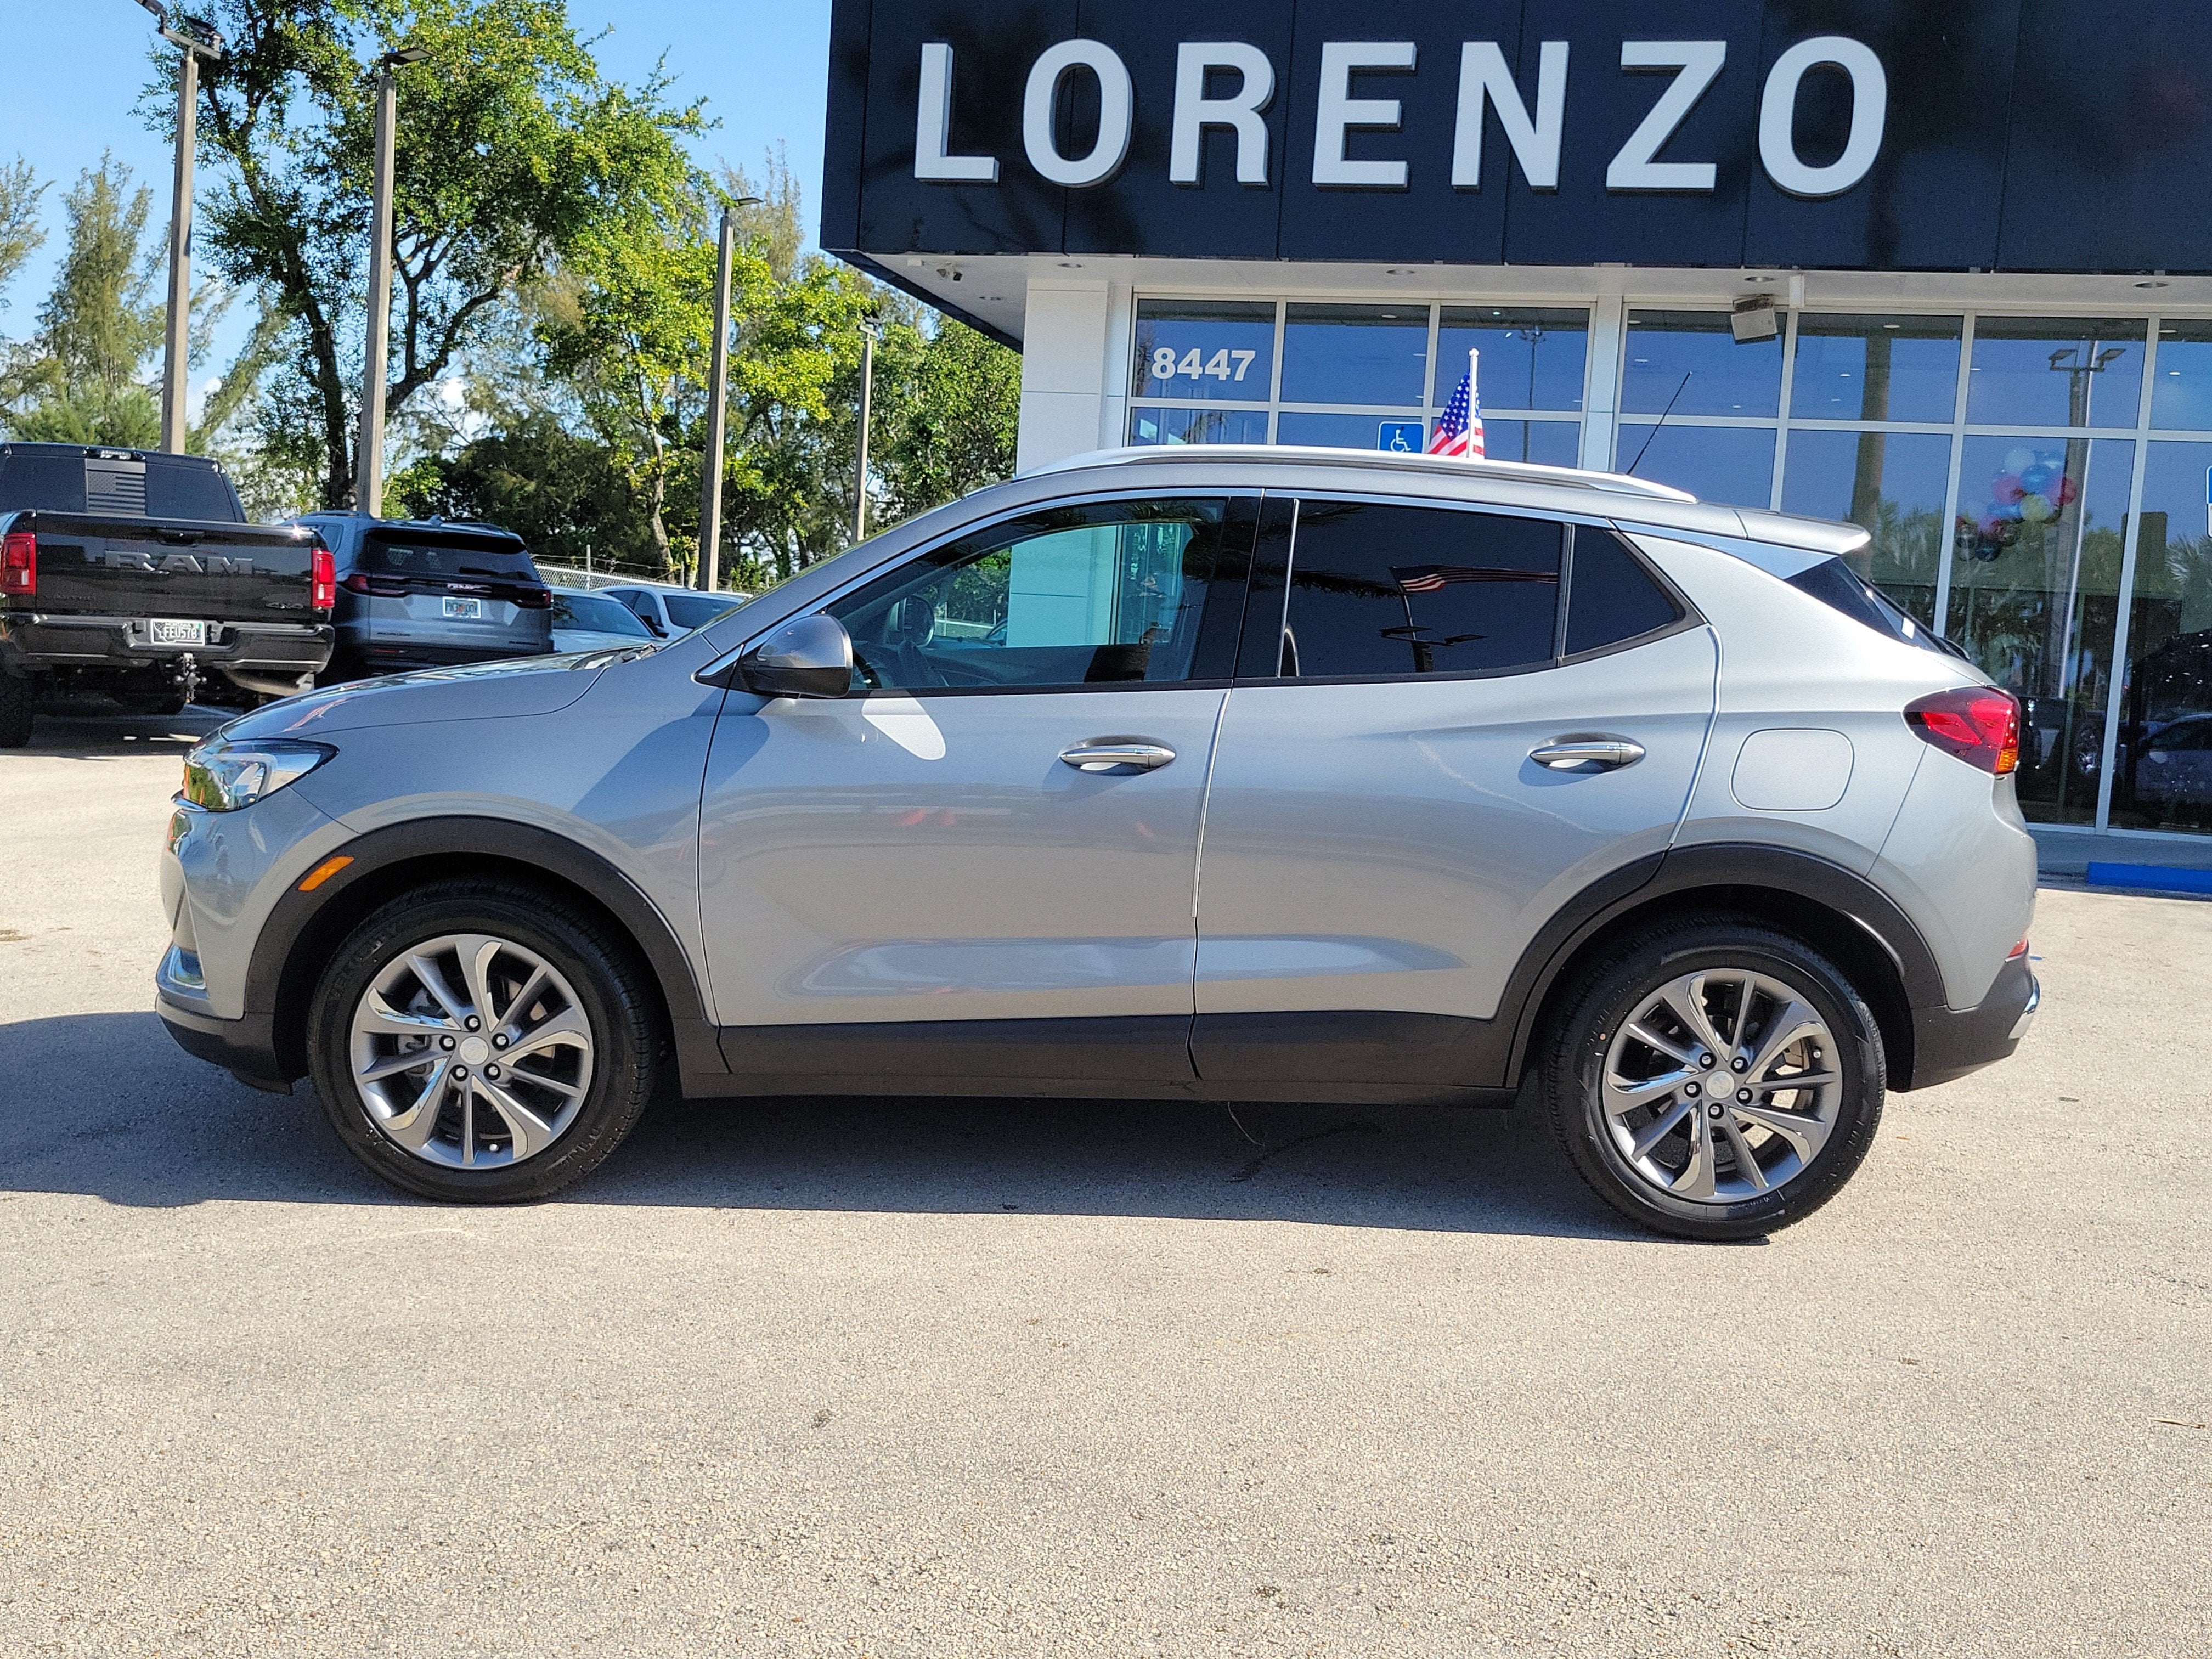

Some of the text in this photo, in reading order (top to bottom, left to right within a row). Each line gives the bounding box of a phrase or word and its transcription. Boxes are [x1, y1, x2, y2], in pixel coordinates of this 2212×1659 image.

[913, 36, 1888, 196] LORENZO
[1152, 347, 1256, 381] 8447
[105, 550, 253, 574] RAM
